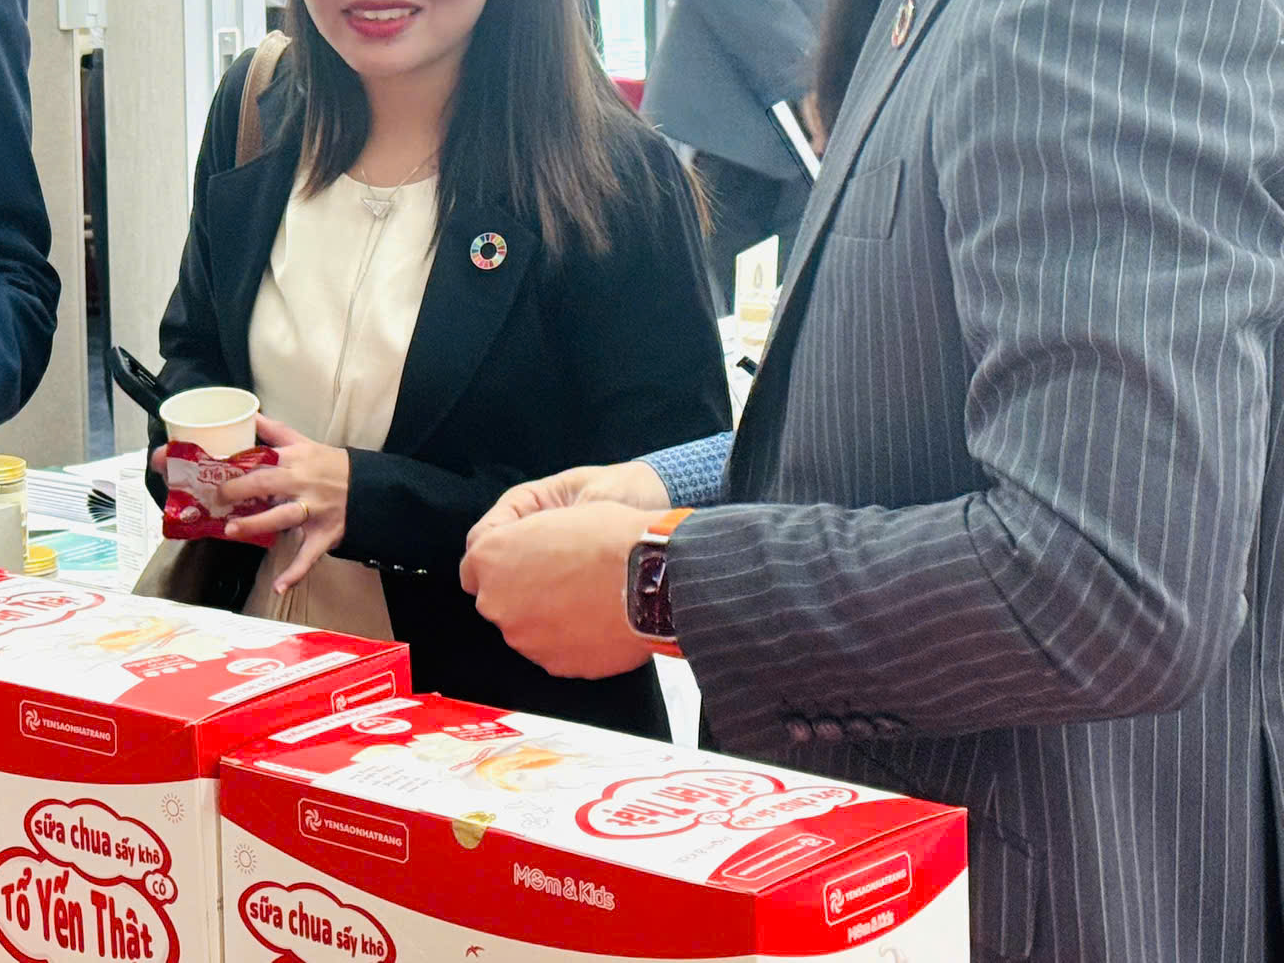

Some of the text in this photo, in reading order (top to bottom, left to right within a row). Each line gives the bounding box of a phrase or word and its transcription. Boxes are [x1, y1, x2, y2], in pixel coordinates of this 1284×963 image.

[324, 819, 403, 847] YENSAONHATRANG
[602, 798, 696, 828] Thật
[34, 813, 161, 867] sữa chua sấy khô
[513, 861, 616, 911] Mom & Kids
[1, 867, 154, 963] Tổ Yến Thật
[249, 896, 384, 958] sữa chua sấy khô
